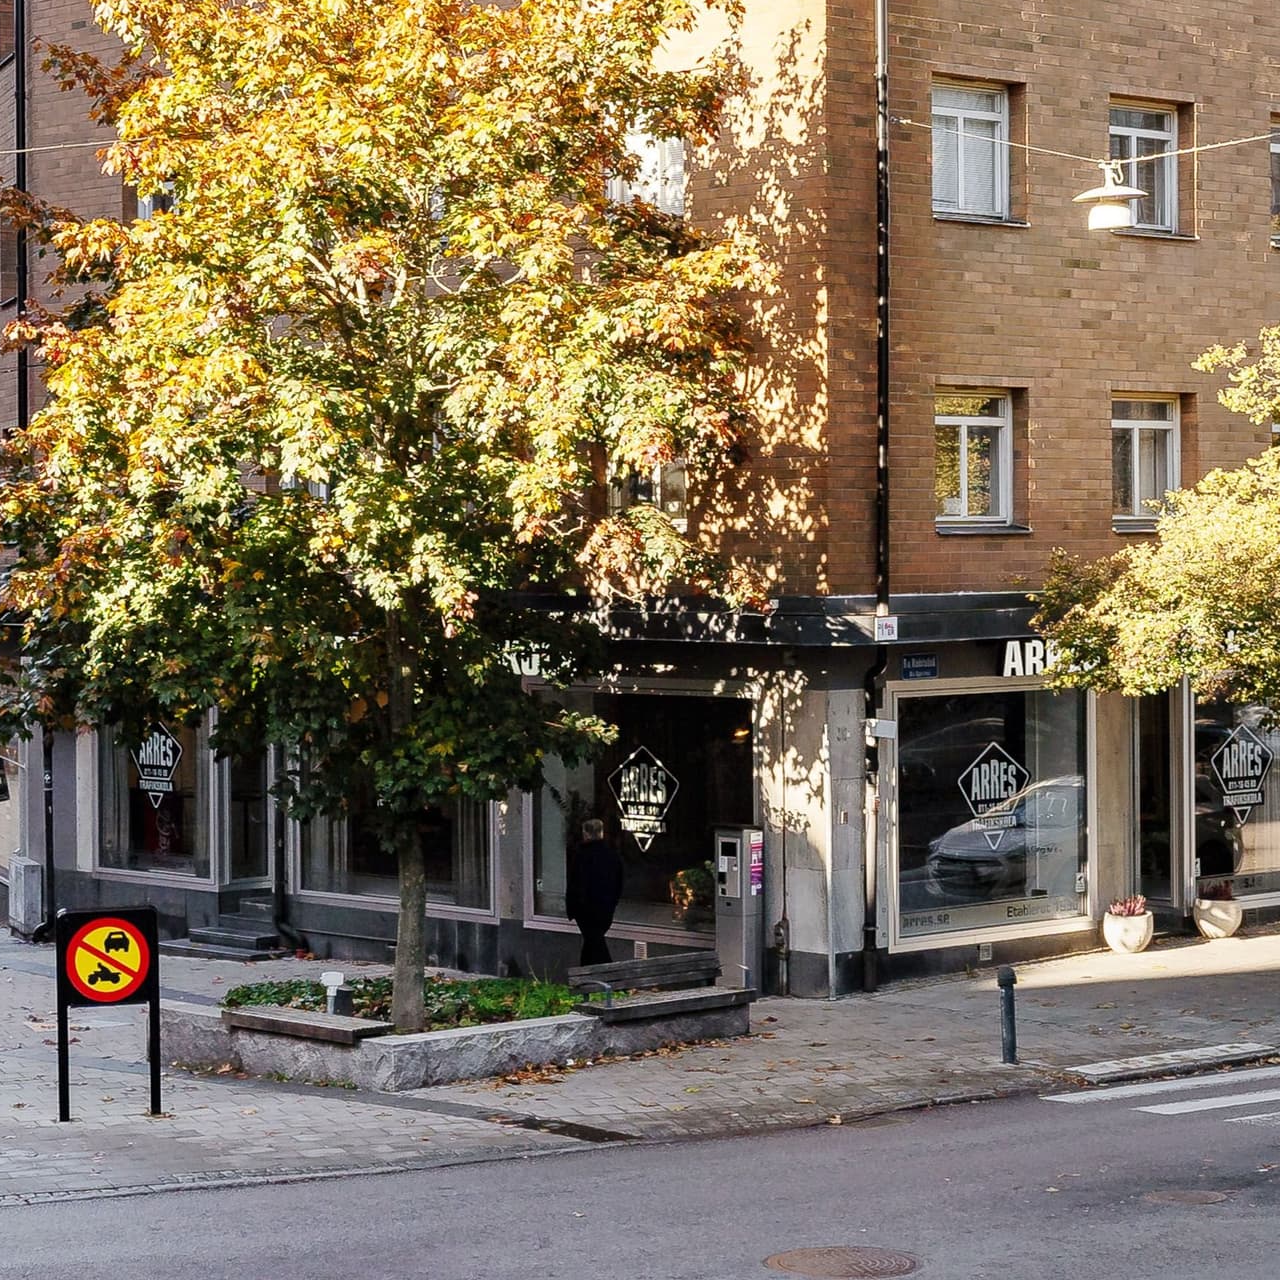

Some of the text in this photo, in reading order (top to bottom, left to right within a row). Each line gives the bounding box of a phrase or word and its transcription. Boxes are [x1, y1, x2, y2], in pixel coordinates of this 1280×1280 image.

[1003, 639, 1101, 677] ARR
[139, 732, 173, 767] ARRES
[1223, 740, 1262, 779] ARRES
[620, 763, 666, 804] ARRES
[971, 759, 1016, 801] ARRES
